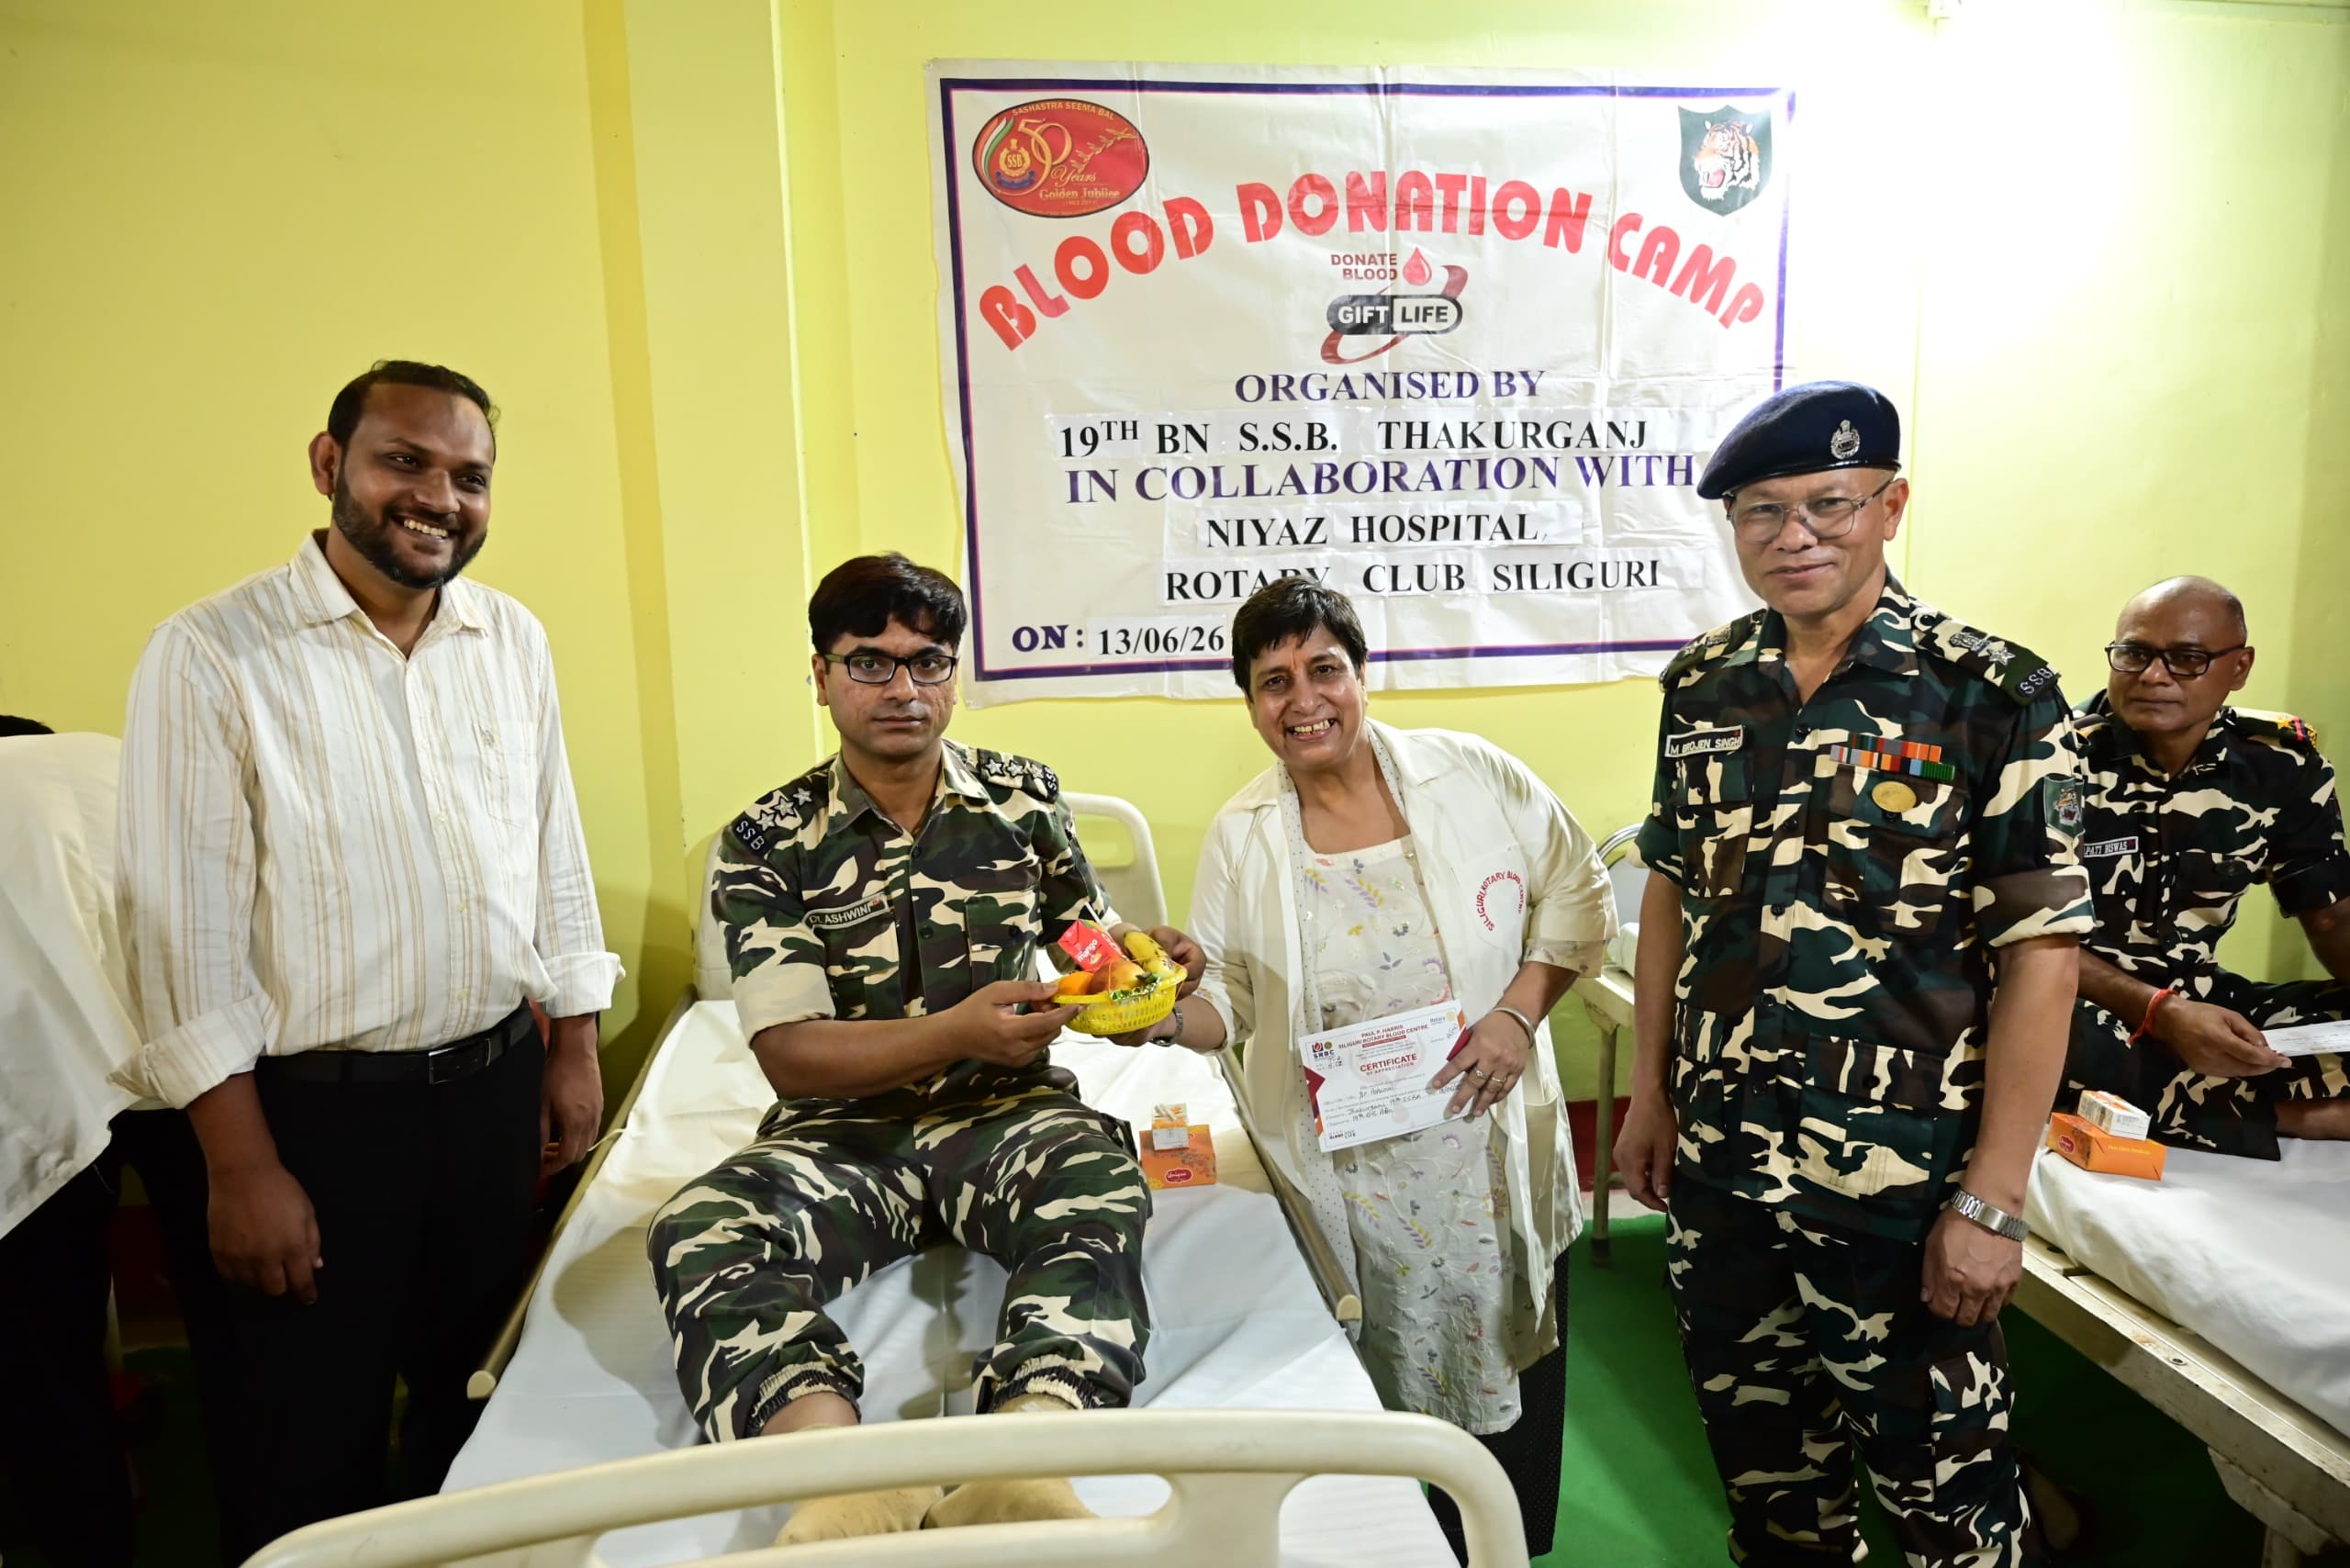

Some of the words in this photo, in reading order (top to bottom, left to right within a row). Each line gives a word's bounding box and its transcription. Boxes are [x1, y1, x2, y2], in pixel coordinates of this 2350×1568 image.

[1013, 102, 1063, 117] SASHASTRA
[1065, 102, 1096, 113] SEEMA
[1098, 108, 1114, 120] BAL
[1007, 154, 1022, 167] SSB
[1052, 165, 1096, 187] Years
[1039, 188, 1079, 200] Golden
[1082, 186, 1120, 199] Jubilee
[979, 196, 1214, 351] BLOOD
[1237, 170, 1593, 254] DONATION
[1607, 213, 1764, 330] CAMP
[1331, 253, 1397, 266] DONATE
[1342, 268, 1397, 281] BLOOD
[1337, 306, 1389, 324] GIFT
[1401, 306, 1449, 323] LIFE
[1236, 371, 1480, 402] ORGANISED
[1492, 370, 1547, 398] BY
[1059, 420, 1139, 458] 19TH
[1156, 424, 1210, 454] BN
[1239, 421, 1337, 452] S.S.B.
[1377, 420, 1648, 450] THAKURGANJ
[1065, 468, 1120, 504] IN
[1135, 456, 1559, 501] COLLABORATION
[1573, 454, 1695, 487] WITH
[1206, 516, 1328, 548] NIYAZ
[1362, 563, 1466, 593] CLUB
[1493, 559, 1661, 591] SILIGURI
[1099, 624, 1225, 655] 13/06/26
[2020, 667, 2053, 695] SSB
[735, 820, 766, 850] SSB
[2084, 845, 2102, 856] PATI
[1481, 871, 1505, 891] ROTARY
[824, 903, 872, 924] ASHWINI
[1078, 939, 1098, 962] mango
[1362, 1035, 1384, 1043] ROTARY
[1386, 1029, 1405, 1038] BLOOD
[1314, 1049, 1335, 1059] SRBC
[1360, 1053, 1418, 1072] CERTIFICATE
[1373, 1061, 1415, 1075] APPRECIATION
